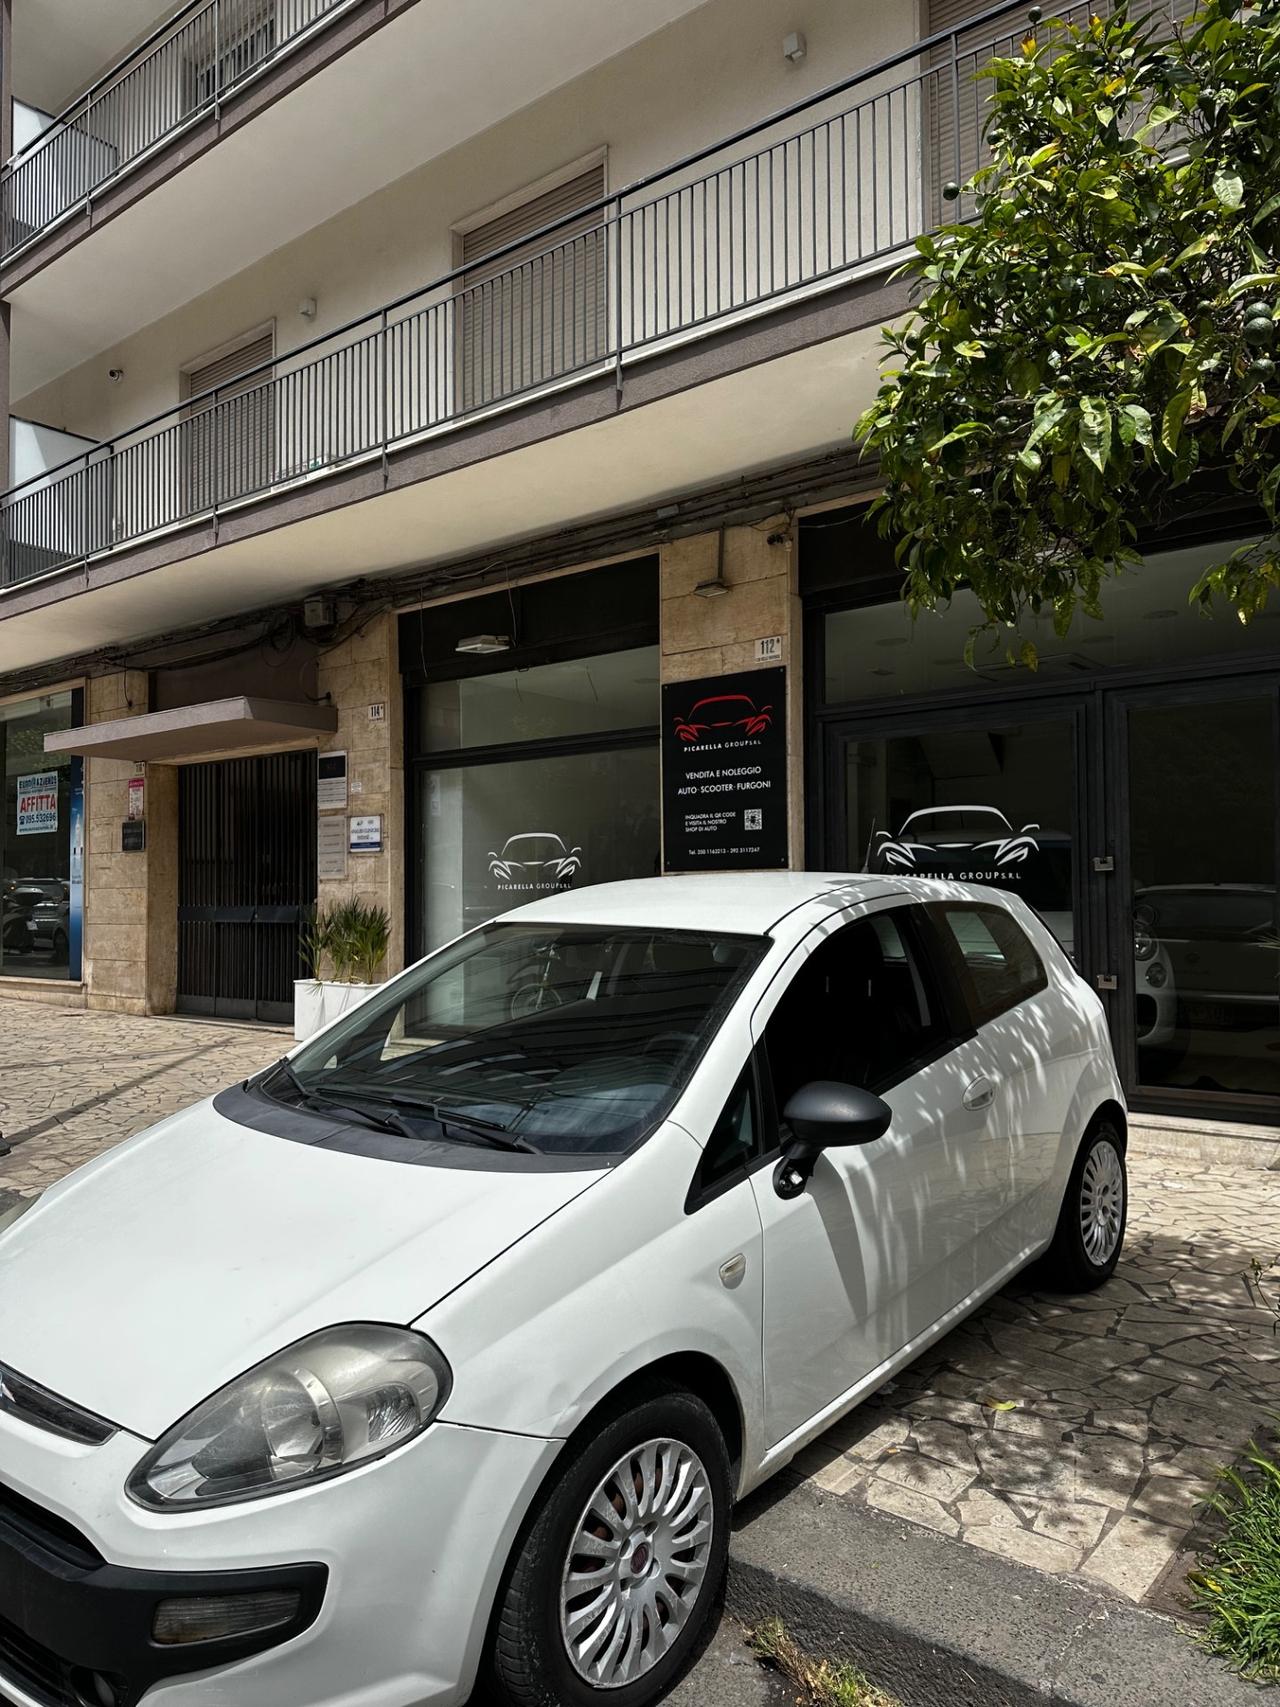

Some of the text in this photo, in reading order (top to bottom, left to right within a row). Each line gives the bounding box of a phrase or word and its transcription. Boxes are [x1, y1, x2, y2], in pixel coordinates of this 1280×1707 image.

[684, 744, 722, 752] PICARELLA
[685, 770, 714, 779] VENDITA
[722, 766, 761, 776] NOLEGGIO
[678, 781, 771, 795] AUTO SCOOTER FURGONI
[20, 794, 56, 813] AFFITTA
